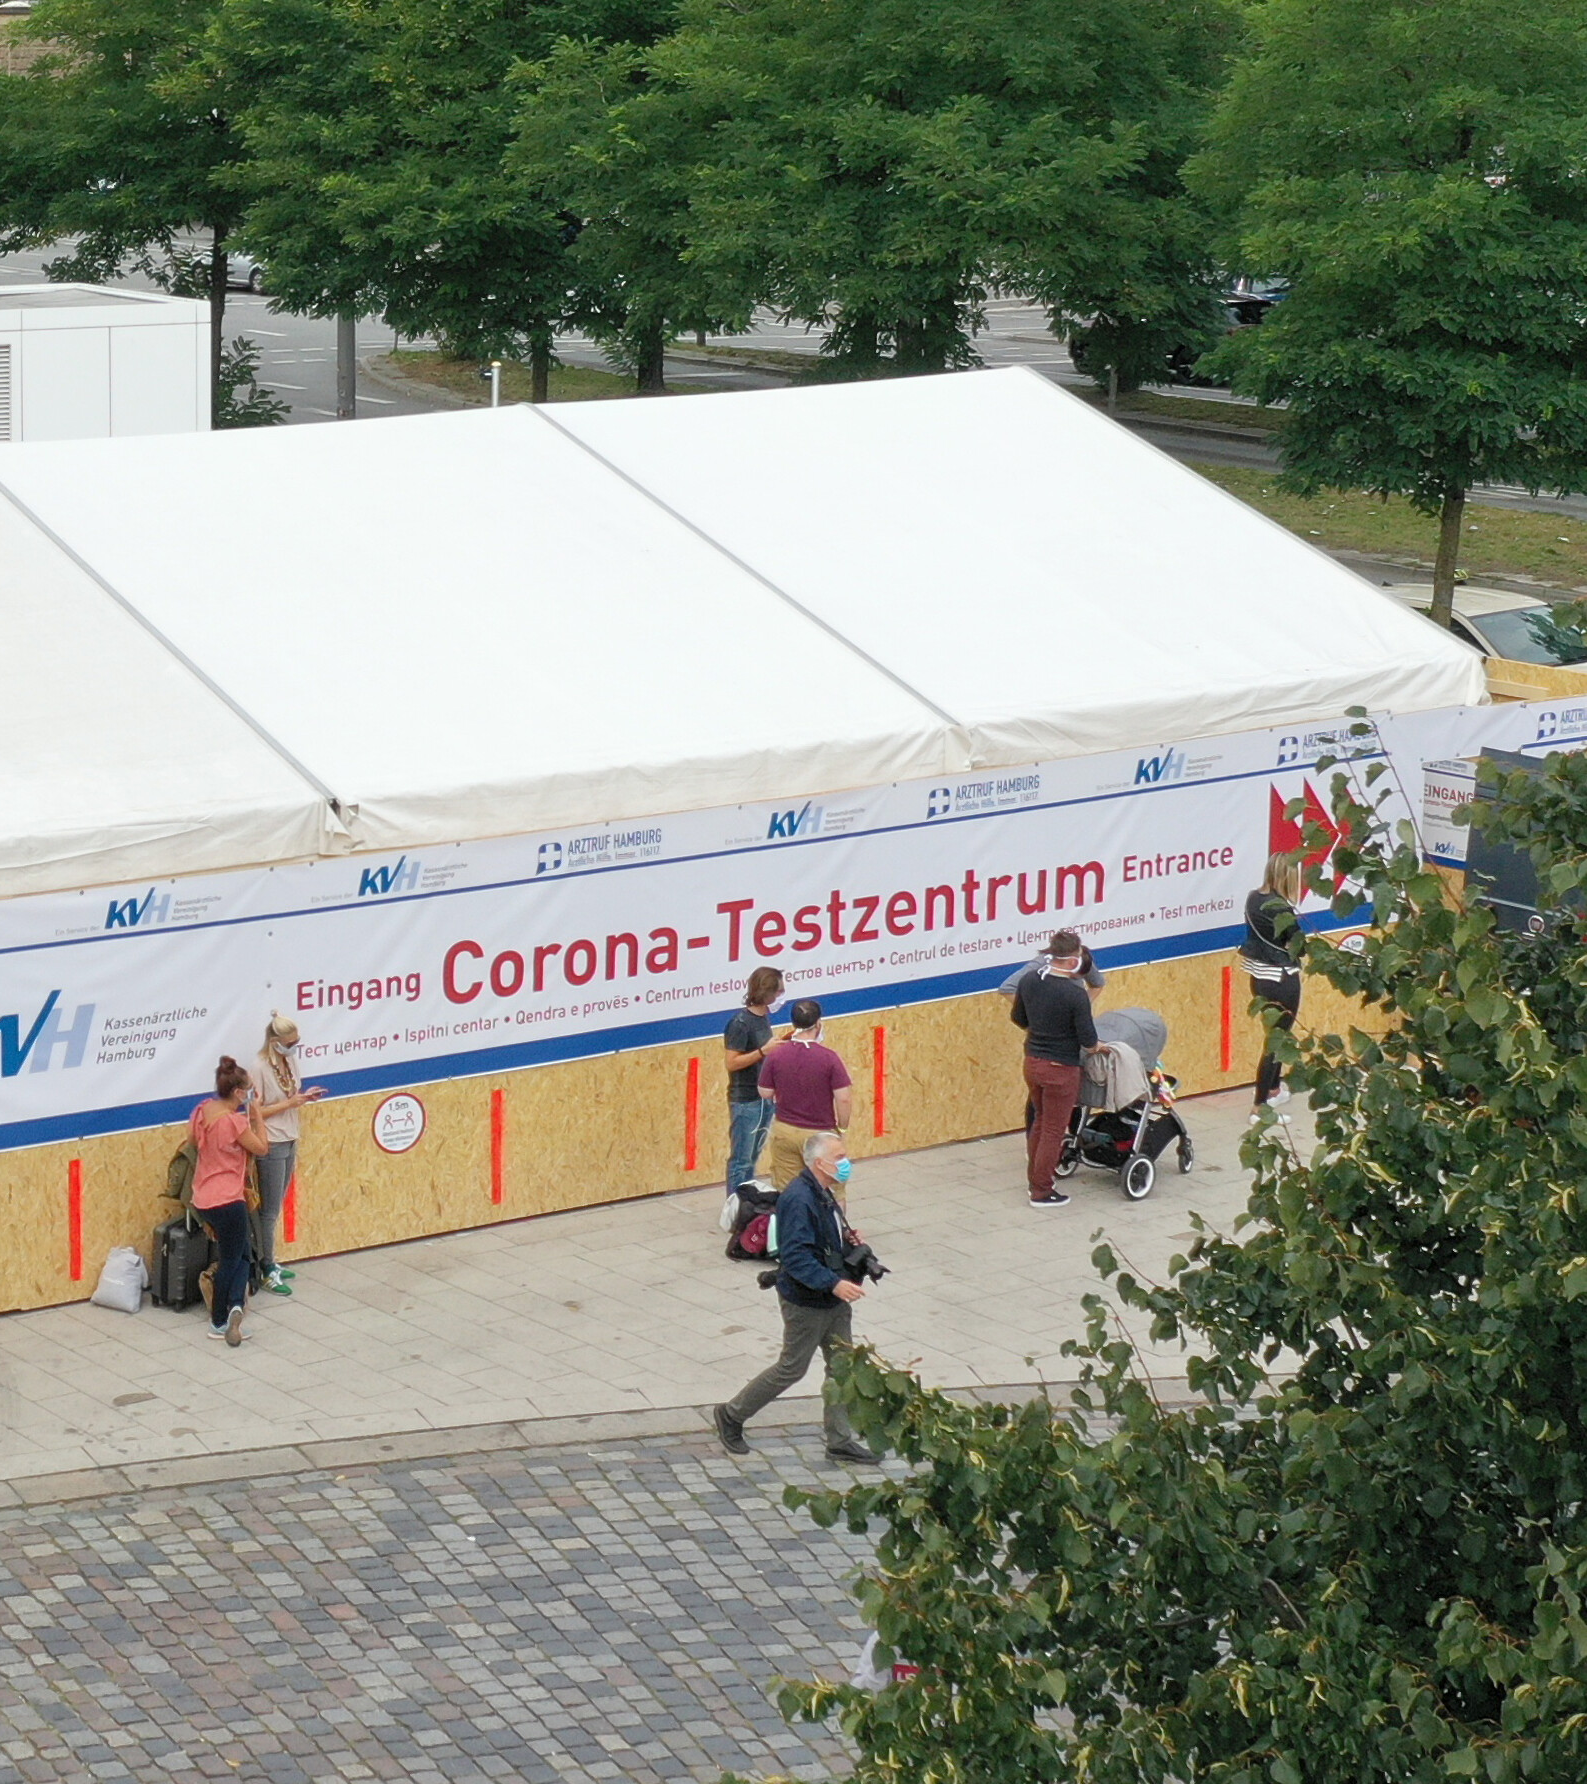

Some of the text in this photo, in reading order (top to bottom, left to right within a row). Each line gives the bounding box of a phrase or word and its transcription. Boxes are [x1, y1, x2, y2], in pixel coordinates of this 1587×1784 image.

[1134, 747, 1185, 785] KVH
[955, 774, 1040, 801] ARZTRUF HAMBURG
[767, 800, 824, 840] KVH
[568, 828, 662, 856] ARZTRUF HAMBURG
[358, 855, 421, 897] KVH
[104, 886, 172, 930] KVH
[297, 846, 1234, 1011] Eingang Corona-Testzentrum Entrance
[297, 1043, 329, 1060] Тест
[334, 1035, 387, 1056] центар
[404, 1024, 449, 1045] Ispitni
[453, 1017, 499, 1035] centar
[515, 1005, 566, 1025] Qendra
[570, 1005, 579, 1016] e
[645, 984, 705, 1004] Centrum
[826, 958, 875, 978] център
[889, 945, 937, 966] Centrul
[939, 942, 956, 958] de
[959, 936, 1003, 955] testare
[1158, 905, 1183, 921] Test
[1186, 897, 1234, 917] merkezi
[104, 1006, 208, 1031] Kassenärztliche
[96, 1046, 157, 1065] Hamburg
[101, 1028, 177, 1048] Vereinigung
